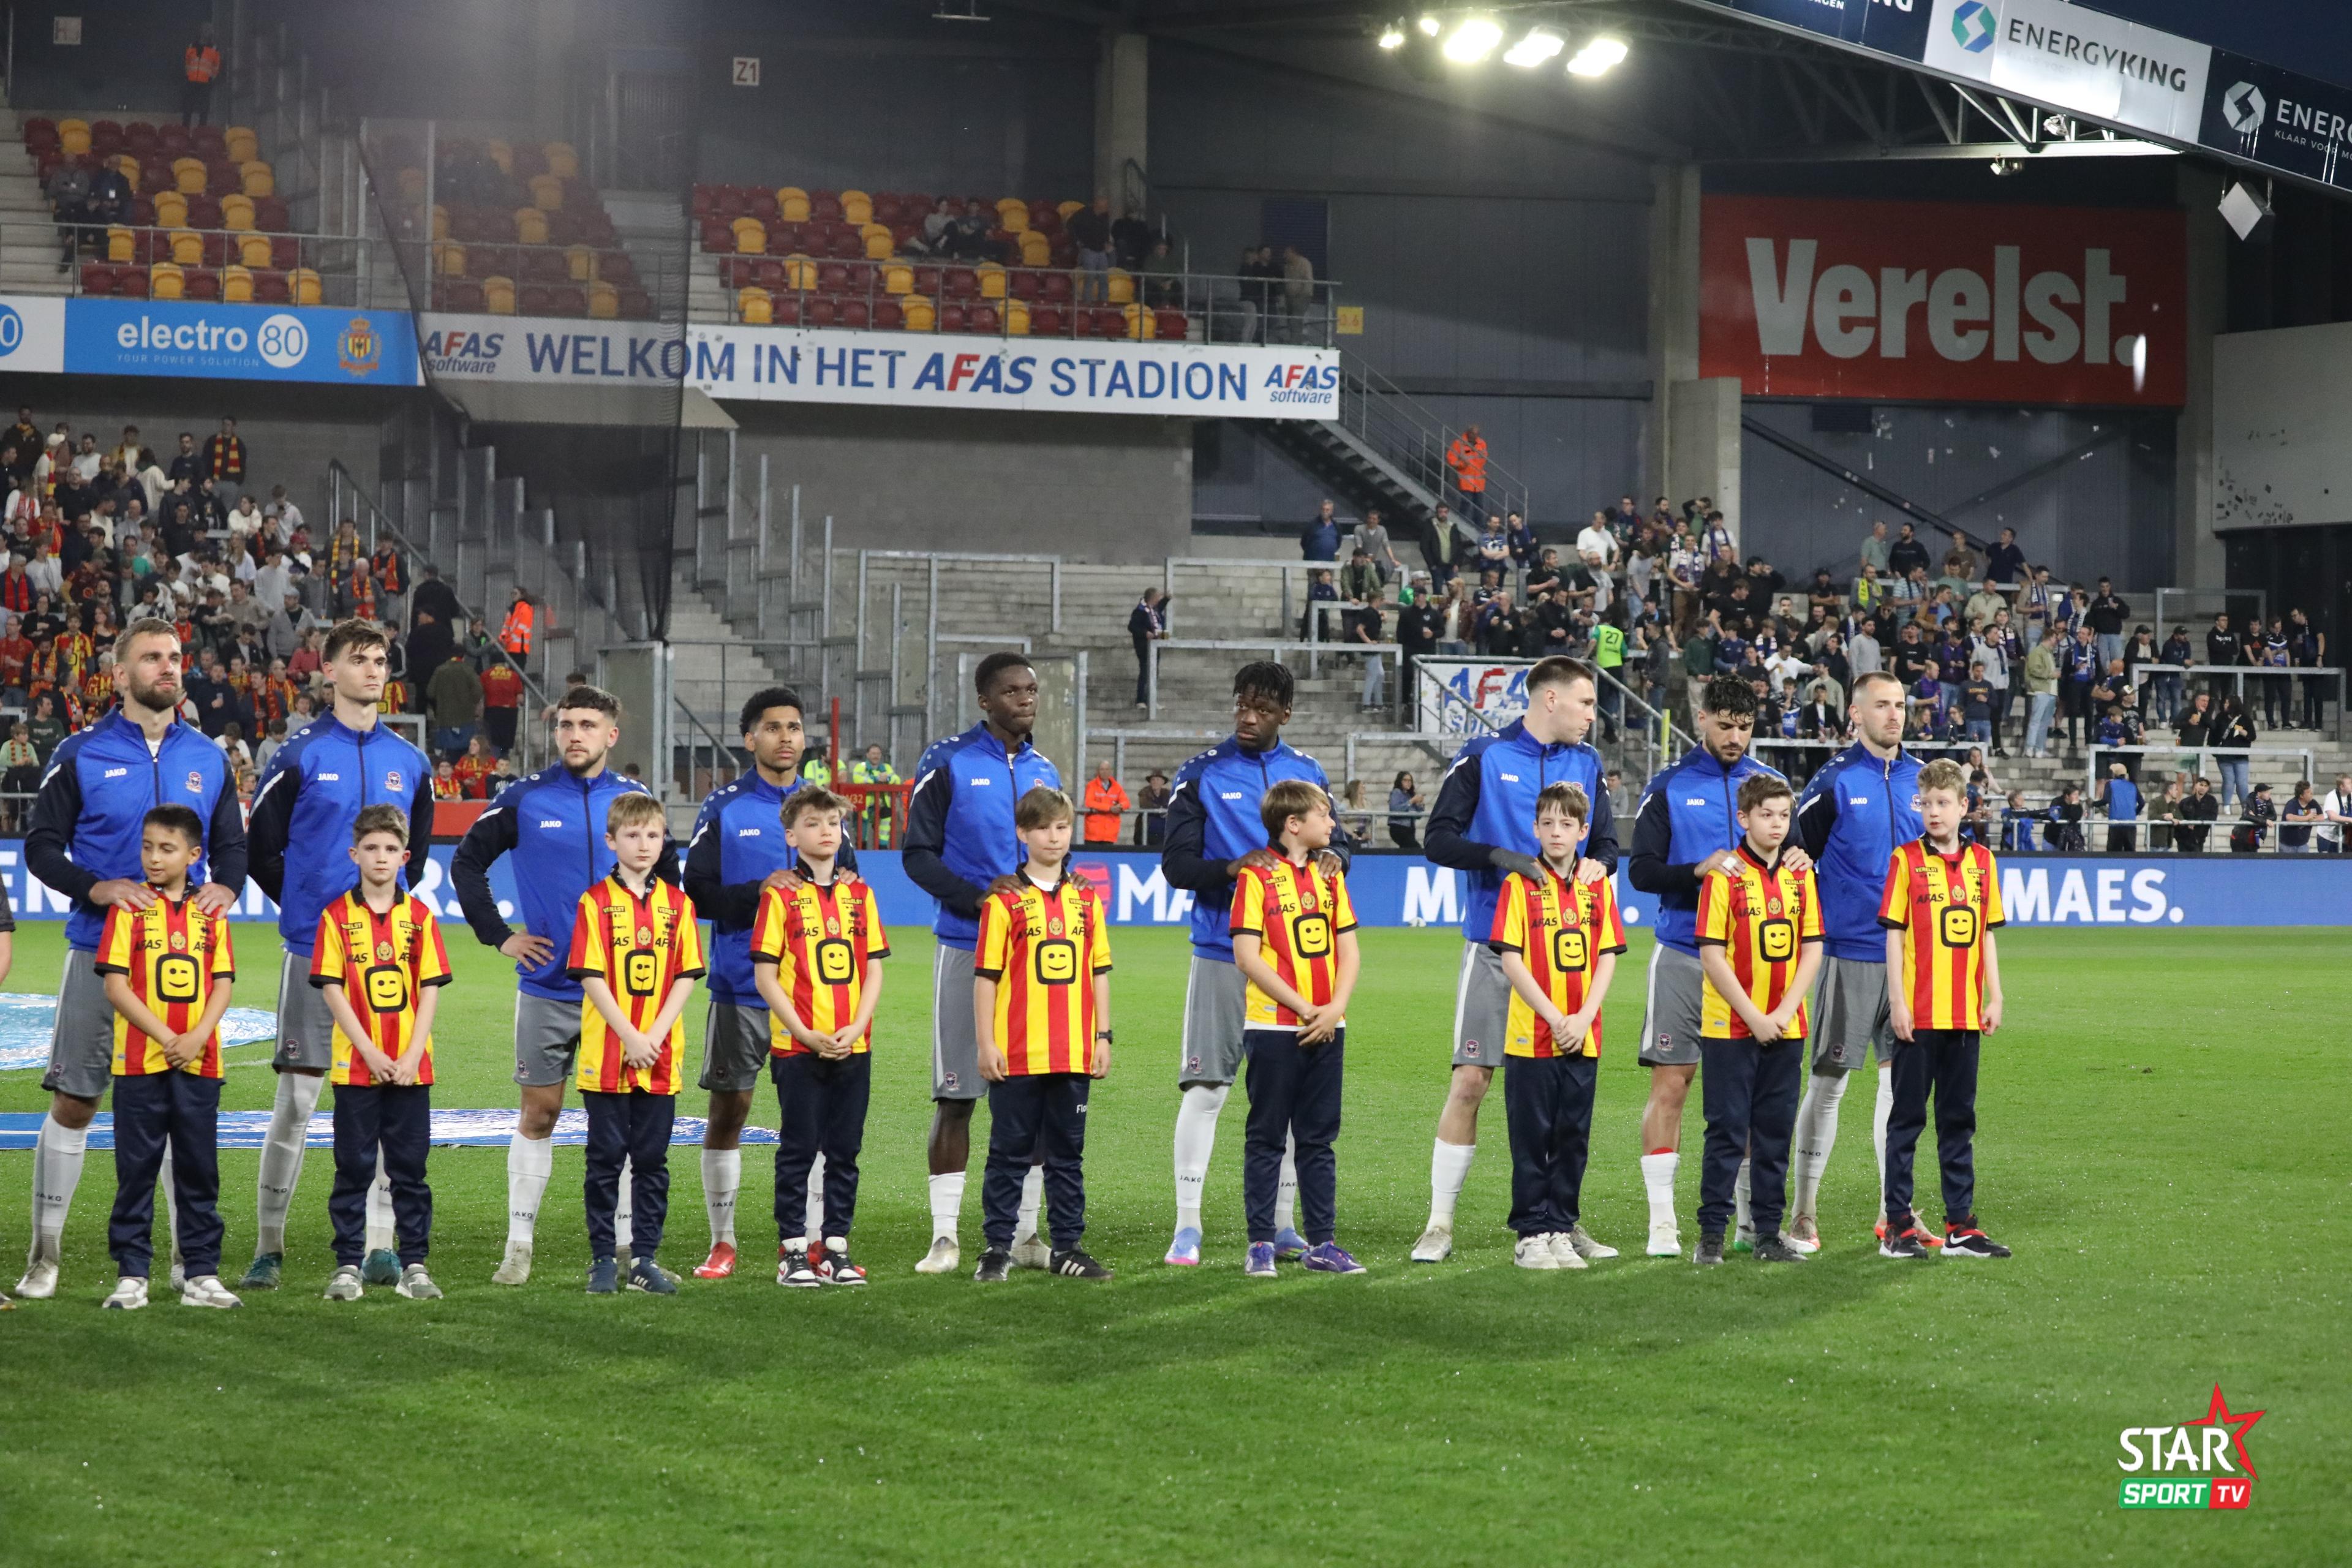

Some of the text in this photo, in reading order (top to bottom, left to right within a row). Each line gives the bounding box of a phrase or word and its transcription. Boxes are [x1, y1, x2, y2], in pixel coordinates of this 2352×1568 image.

[2008, 18, 2186, 92] ENERGYKING
[736, 61, 756, 82] Z1
[2274, 130, 2307, 146] KLAAR
[2310, 140, 2337, 155] VOOR
[117, 315, 304, 357] electro 80
[424, 331, 505, 358] AFAS
[117, 354, 260, 367] YOUR POWER SOLUTION
[428, 356, 496, 374] software
[526, 332, 1246, 401] WELKOM IN HET AFAS STADION
[1264, 364, 1339, 390] AFAS
[1270, 389, 1332, 404] software
[1605, 631, 1619, 644] 27
[105, 768, 127, 778] JAKO
[1501, 773, 1518, 782] JAKO
[1916, 893, 1945, 905] AFAS
[2001, 868, 2184, 923] MAES.
